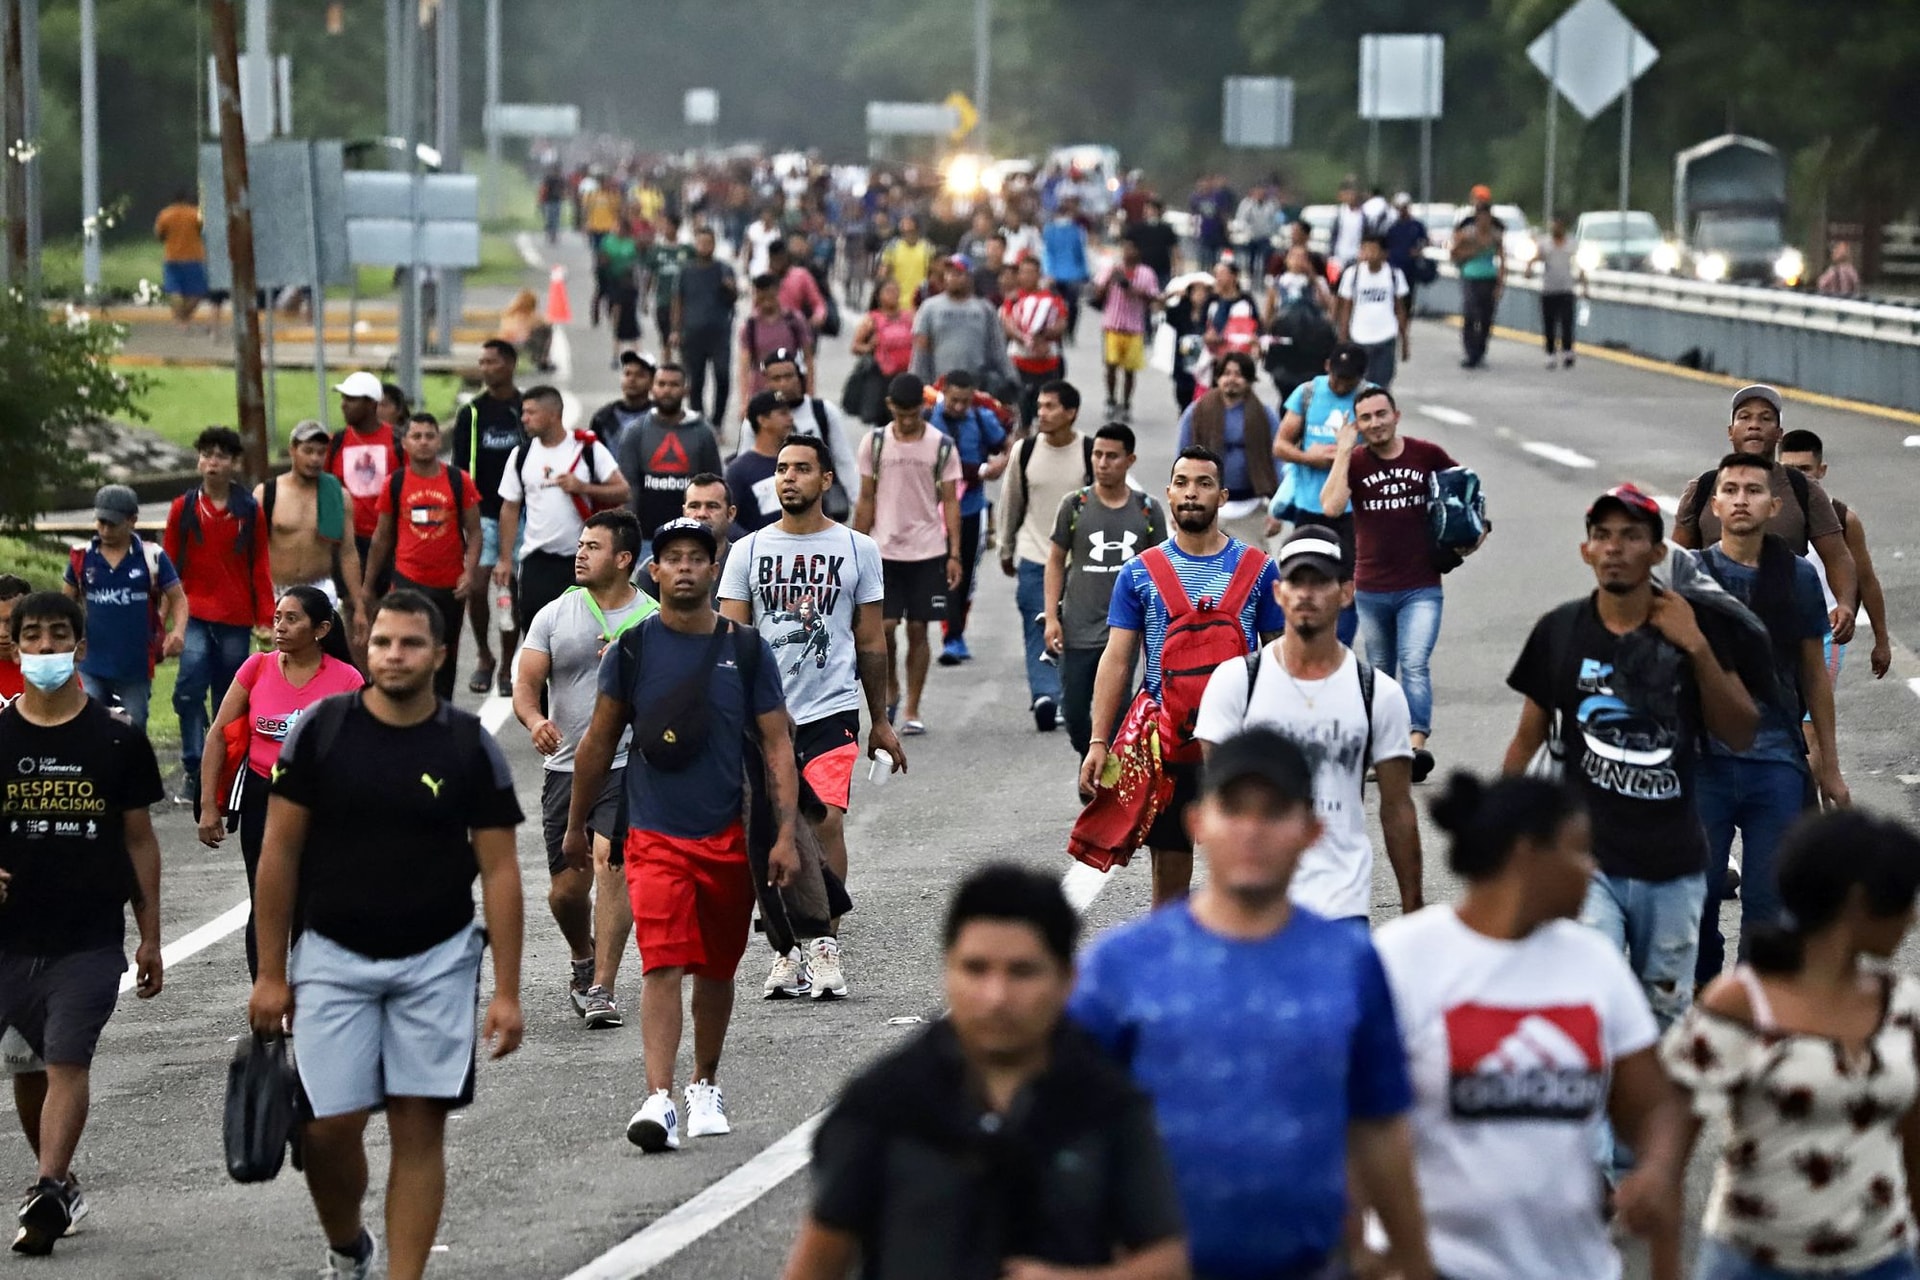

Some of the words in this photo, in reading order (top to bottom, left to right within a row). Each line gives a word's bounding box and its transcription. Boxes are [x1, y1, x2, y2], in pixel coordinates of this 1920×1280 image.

[759, 554, 845, 587] BLACK
[7, 780, 94, 799] RESPETO
[21, 798, 39, 811] AL
[40, 797, 106, 812] RACISMO
[54, 821, 80, 833] BAM
